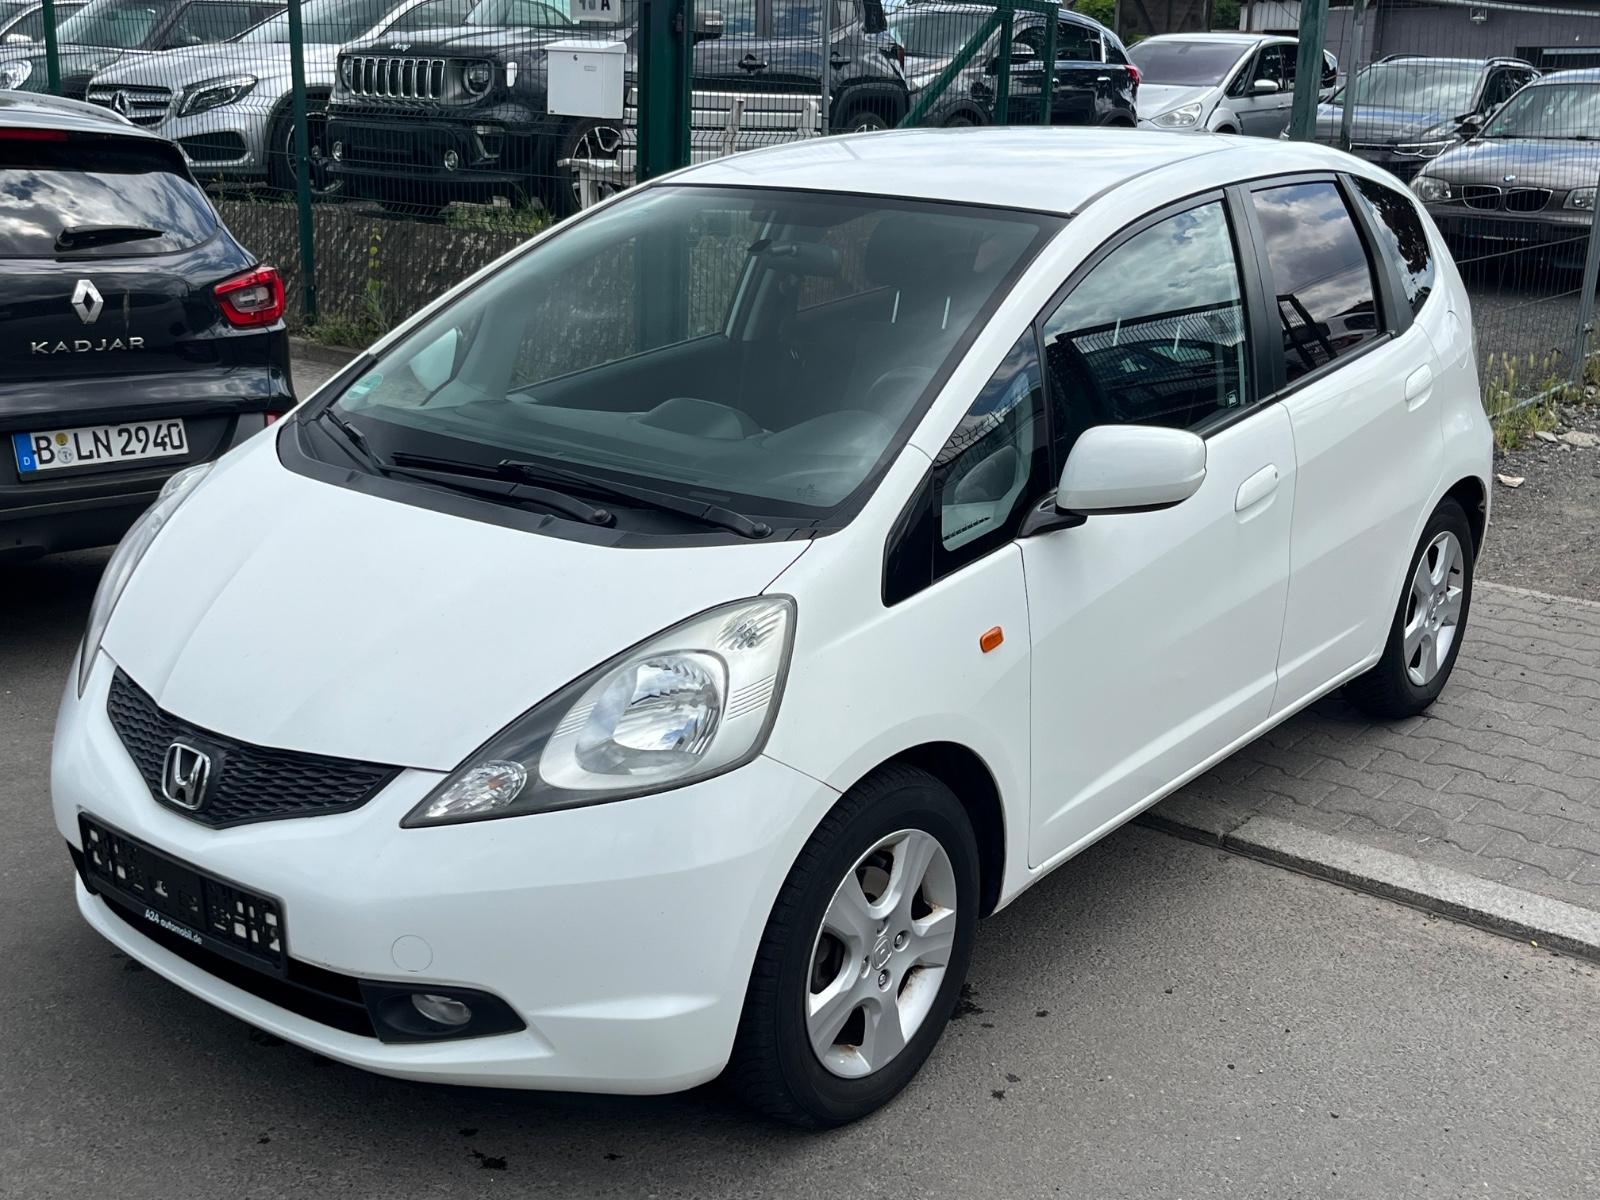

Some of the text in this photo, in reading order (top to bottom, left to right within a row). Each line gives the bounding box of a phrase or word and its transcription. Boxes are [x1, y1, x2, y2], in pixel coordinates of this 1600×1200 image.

[31, 336, 145, 354] KADJAR
[35, 423, 184, 465] B LN 2940
[24, 457, 31, 466] D
